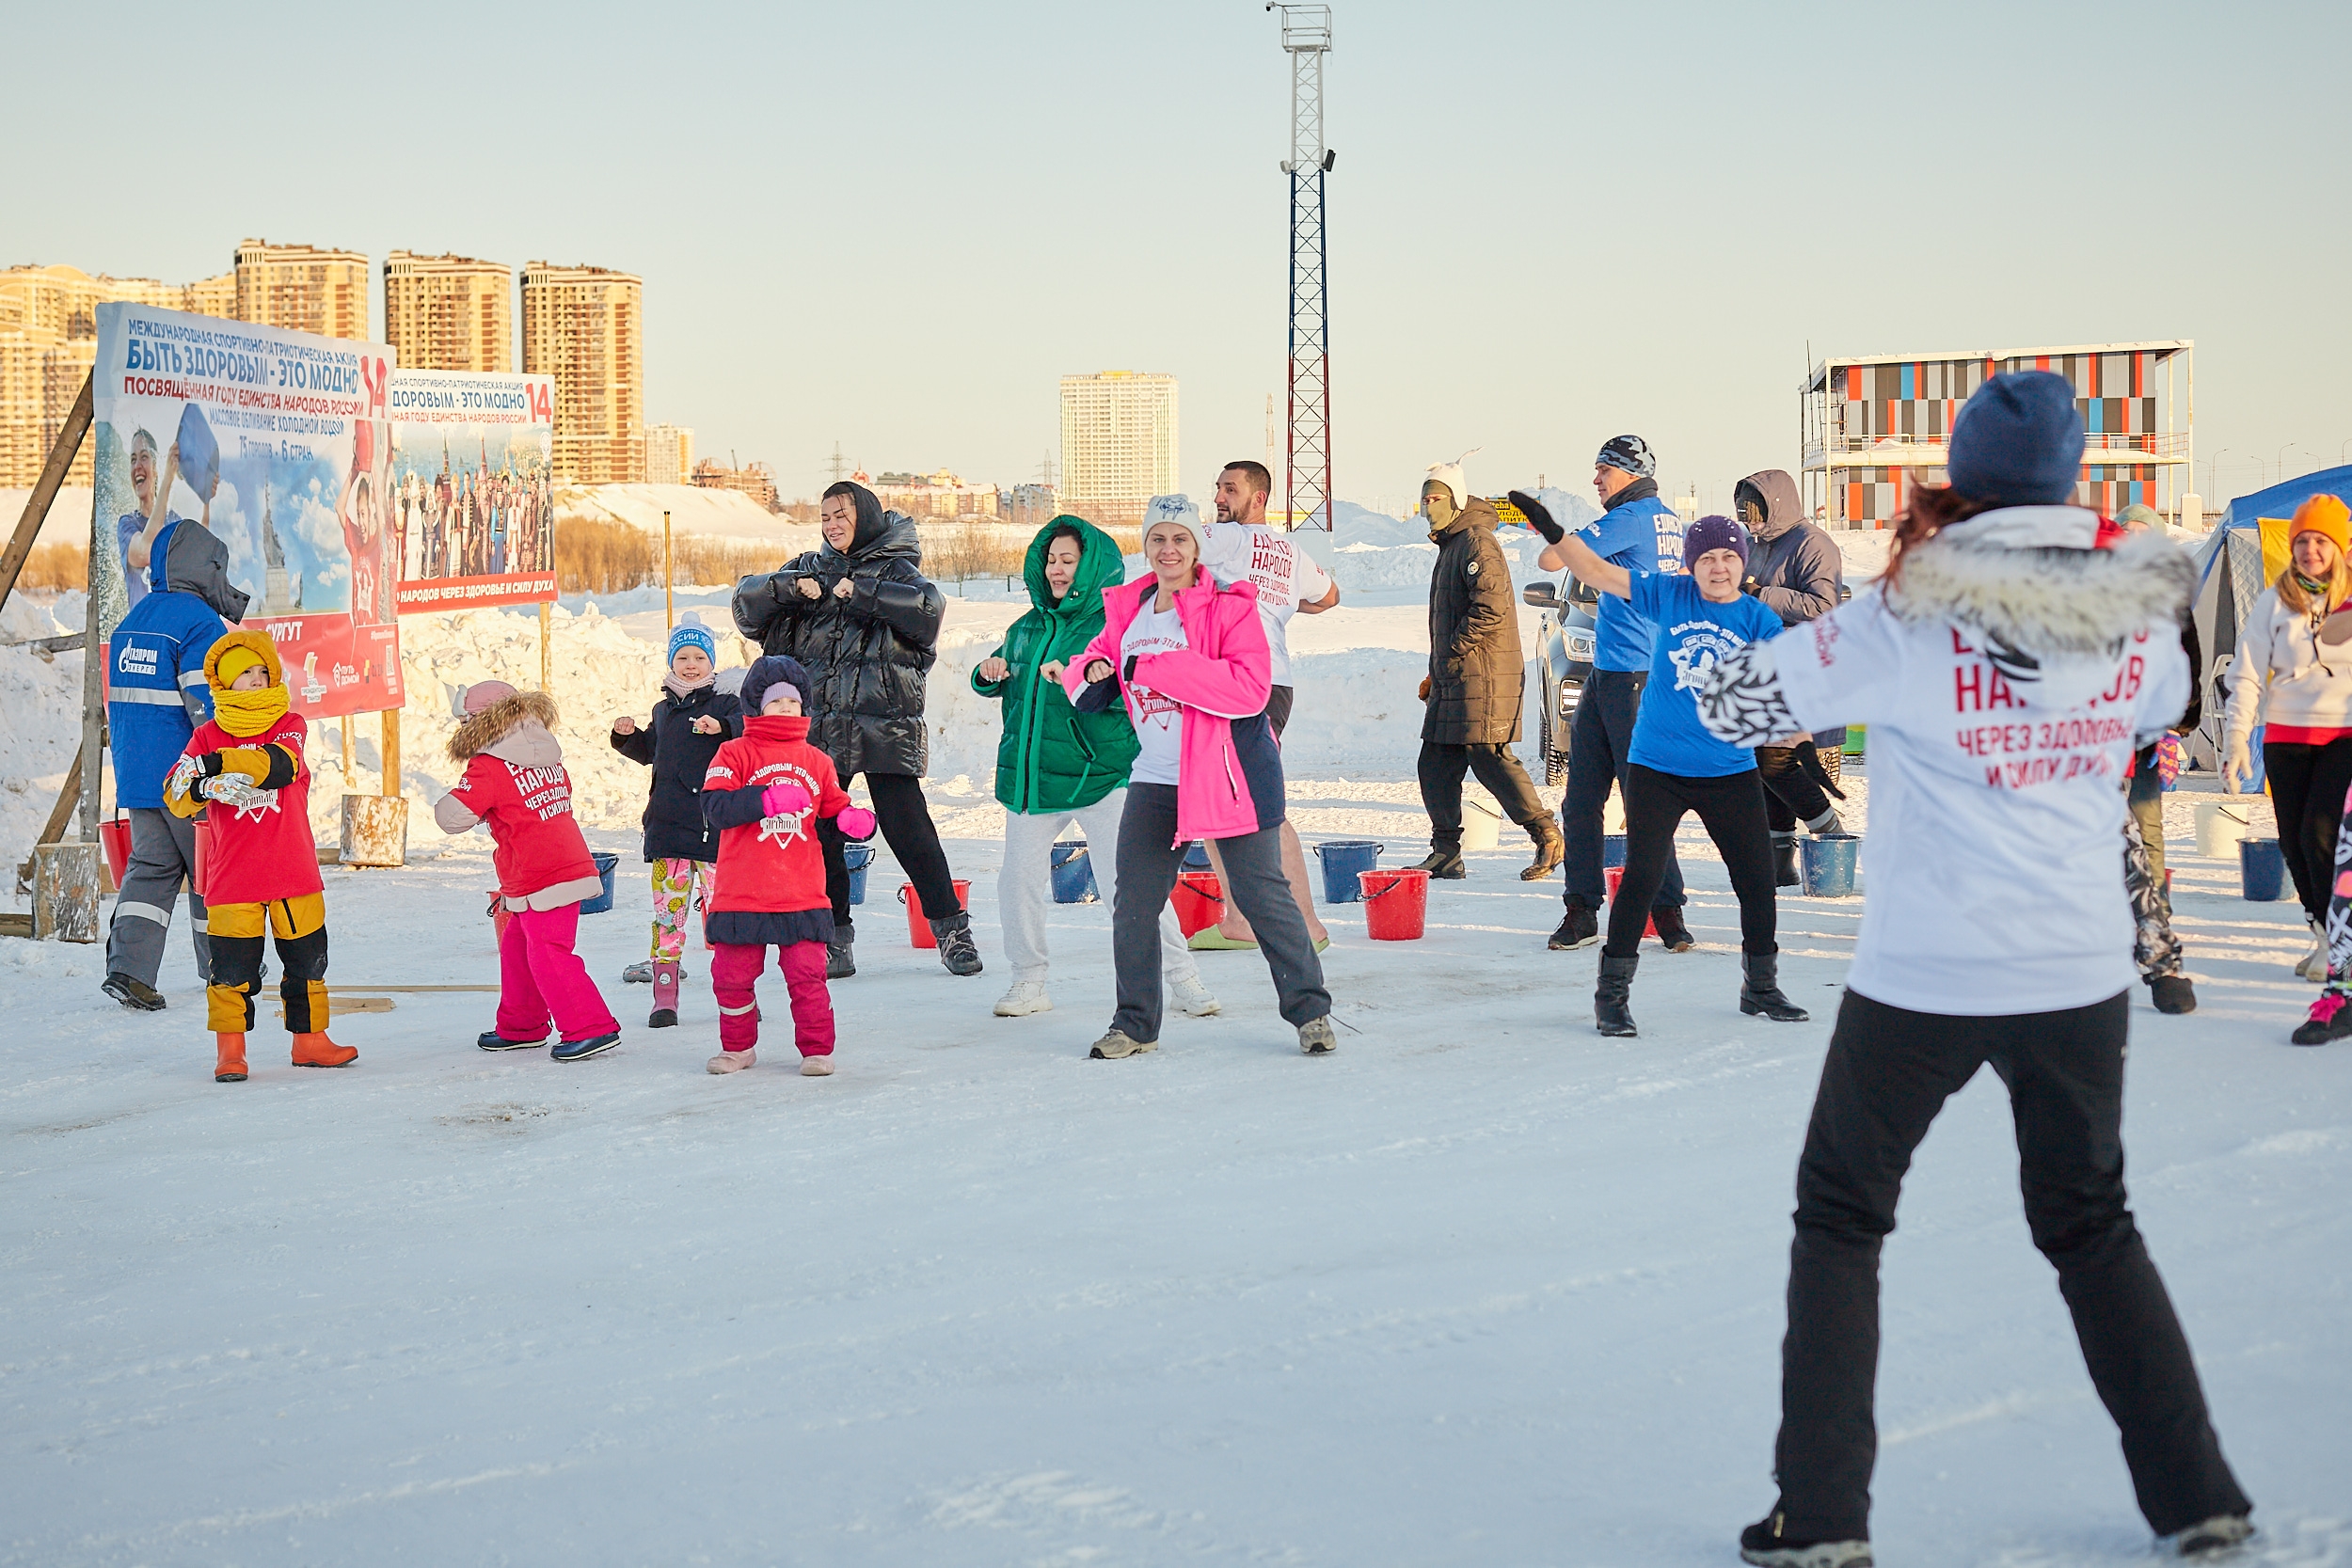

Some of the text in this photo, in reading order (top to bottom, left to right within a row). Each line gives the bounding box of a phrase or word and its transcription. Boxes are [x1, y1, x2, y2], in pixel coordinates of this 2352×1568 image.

[128, 319, 214, 345] МЕЖДУНАРОДНАЯ
[126, 339, 183, 372] БЫТЬ
[183, 344, 268, 386] ЗДОРОВЫМ
[278, 358, 307, 388] ЭТО
[310, 363, 358, 394] МОДНО
[409, 378, 503, 390] СПОРТИВНО-ПАТРИОТИЧЕСКАЯ
[503, 383, 524, 391] АКЦИЯ
[124, 376, 364, 417] ПОСВЯЩЁННАЯ ГОДУ ЕДИНСТВА НАРОДОВ РОССИИ
[462, 391, 483, 408] ЭТО
[485, 392, 525, 409] МОДНО
[525, 383, 552, 423] 14
[278, 415, 319, 436] ХОЛОДНОЙ
[410, 413, 429, 423] ГОДУ
[431, 412, 468, 423] ЕДИНСТВА
[469, 413, 501, 424] НАРОДОВ
[501, 414, 527, 424] РОССИИ
[281, 439, 288, 462] 6
[290, 444, 314, 462] СТРАН
[1251, 551, 1293, 578] НАРОДОВ
[400, 587, 439, 603] НАРОДОВ
[439, 584, 465, 599] ЧЕРЕЗ
[465, 582, 505, 599] ЗДОРОВЬЕ
[505, 581, 512, 594] И
[512, 579, 532, 594] СИЛУ
[532, 578, 554, 594] ДУХА
[1248, 574, 1270, 589] ЧЕРЕЗ
[1261, 591, 1276, 602] СИЛУ
[265, 621, 303, 642] СУРГУТ
[129, 647, 157, 663] ГАЗПРОМ
[128, 664, 156, 674] ЭНЕРГО
[341, 665, 355, 675] ПУТЬ
[341, 672, 360, 687] ДОМОЙ
[1957, 724, 2033, 755] ЧЕРЕЗ
[755, 762, 793, 779] ЗДОРОВЫМ
[794, 767, 807, 778] ЭТО
[804, 772, 821, 797] МОДНО
[1986, 764, 2002, 788] И
[2007, 754, 2061, 789] СИЛУ
[524, 790, 550, 810] ЧЕРЕЗ
[538, 807, 548, 821] И
